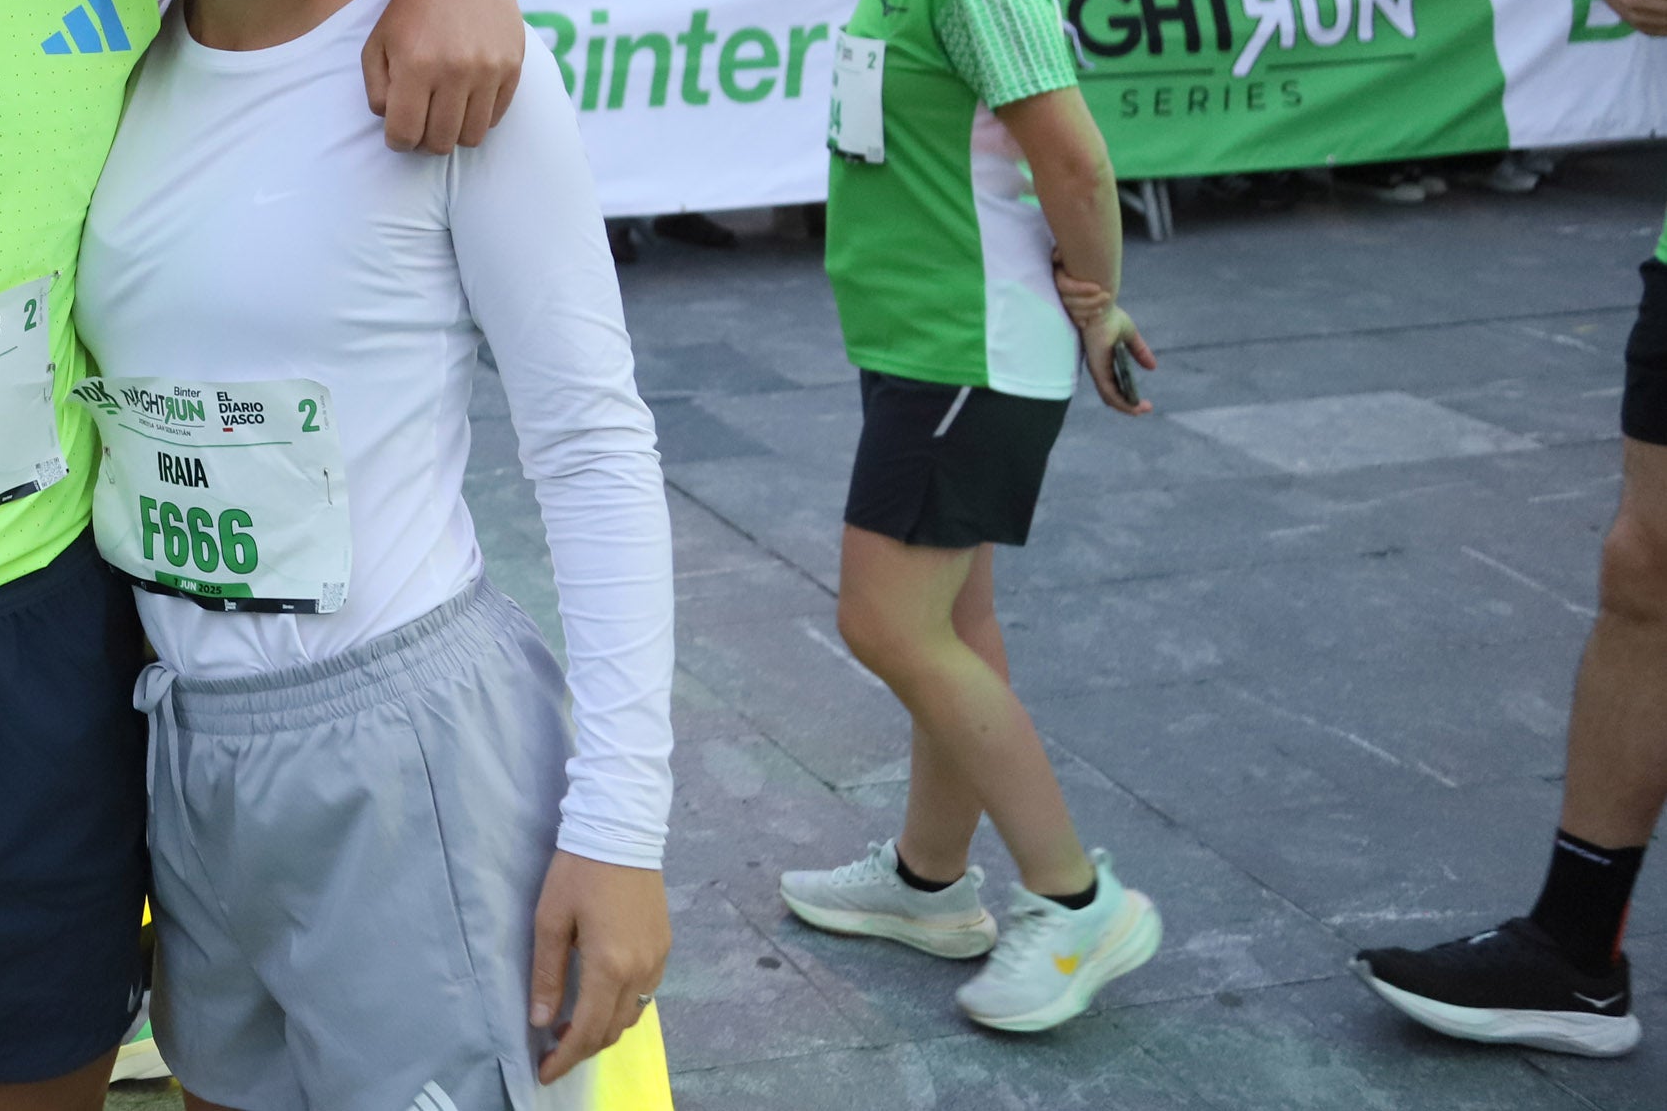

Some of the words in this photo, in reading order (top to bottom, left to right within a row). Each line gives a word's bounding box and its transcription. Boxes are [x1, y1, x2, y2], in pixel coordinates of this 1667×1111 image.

[866, 50, 877, 70] 2
[1120, 79, 1304, 118] SERIES
[23, 298, 36, 331] 2
[72, 380, 122, 411] 10K
[174, 386, 201, 398] Binter
[217, 391, 232, 402] EL
[218, 402, 264, 414] DIARIO
[220, 413, 265, 426] VASCO
[298, 399, 320, 432] 2
[157, 451, 209, 488] IRAIA
[139, 495, 259, 575] F666
[180, 580, 197, 591] JUN
[198, 583, 223, 595] 2025
